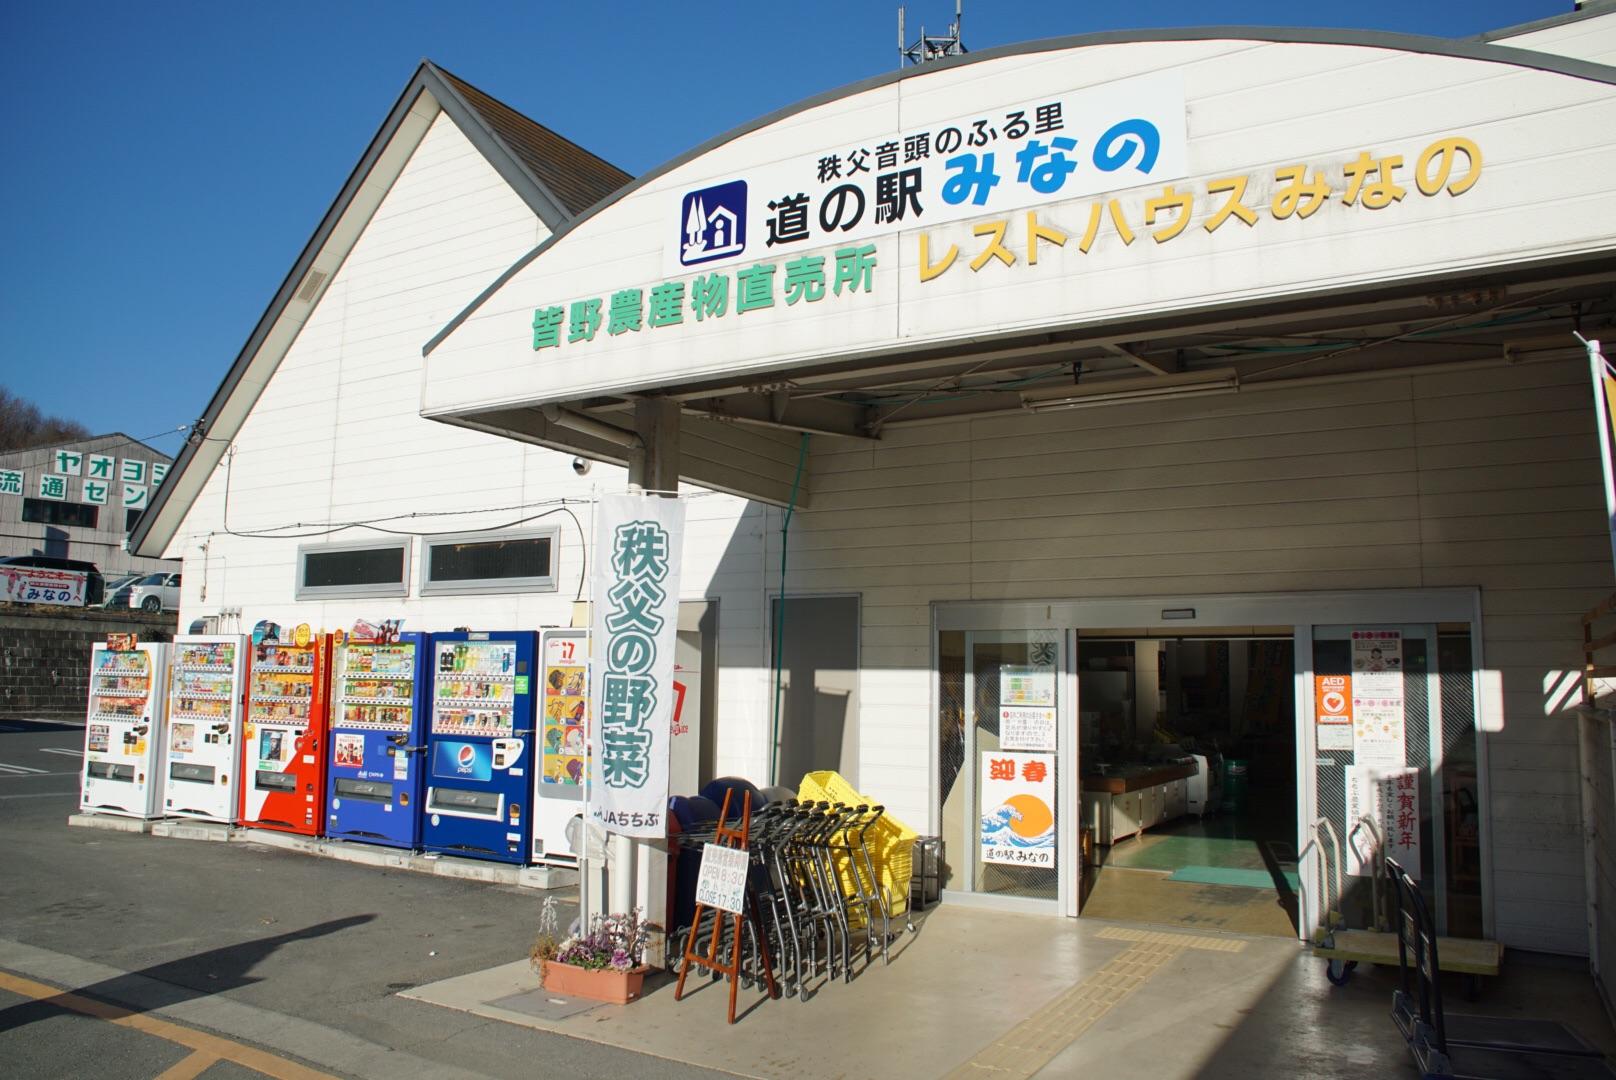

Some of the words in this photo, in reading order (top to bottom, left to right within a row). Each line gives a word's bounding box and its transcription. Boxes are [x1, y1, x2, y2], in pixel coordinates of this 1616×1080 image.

[817, 102, 1064, 183] 秩父音頭のふる里
[766, 166, 923, 247] 道の駅
[941, 118, 1160, 206] みなの
[919, 137, 1482, 283] レストハウスみなの
[532, 244, 877, 350] 皆野農産物直売所
[601, 520, 668, 789] 秩父の野菜
[1322, 677, 1345, 685] AED
[989, 758, 1048, 782] 迎春
[603, 810, 659, 827] JAちちぶ
[1396, 774, 1416, 850] 謹賀新年
[702, 864, 721, 880] OPEN
[985, 848, 1049, 863] 道の駅みなの
[698, 889, 717, 904] CLOSE
[718, 893, 741, 911] 17:30
